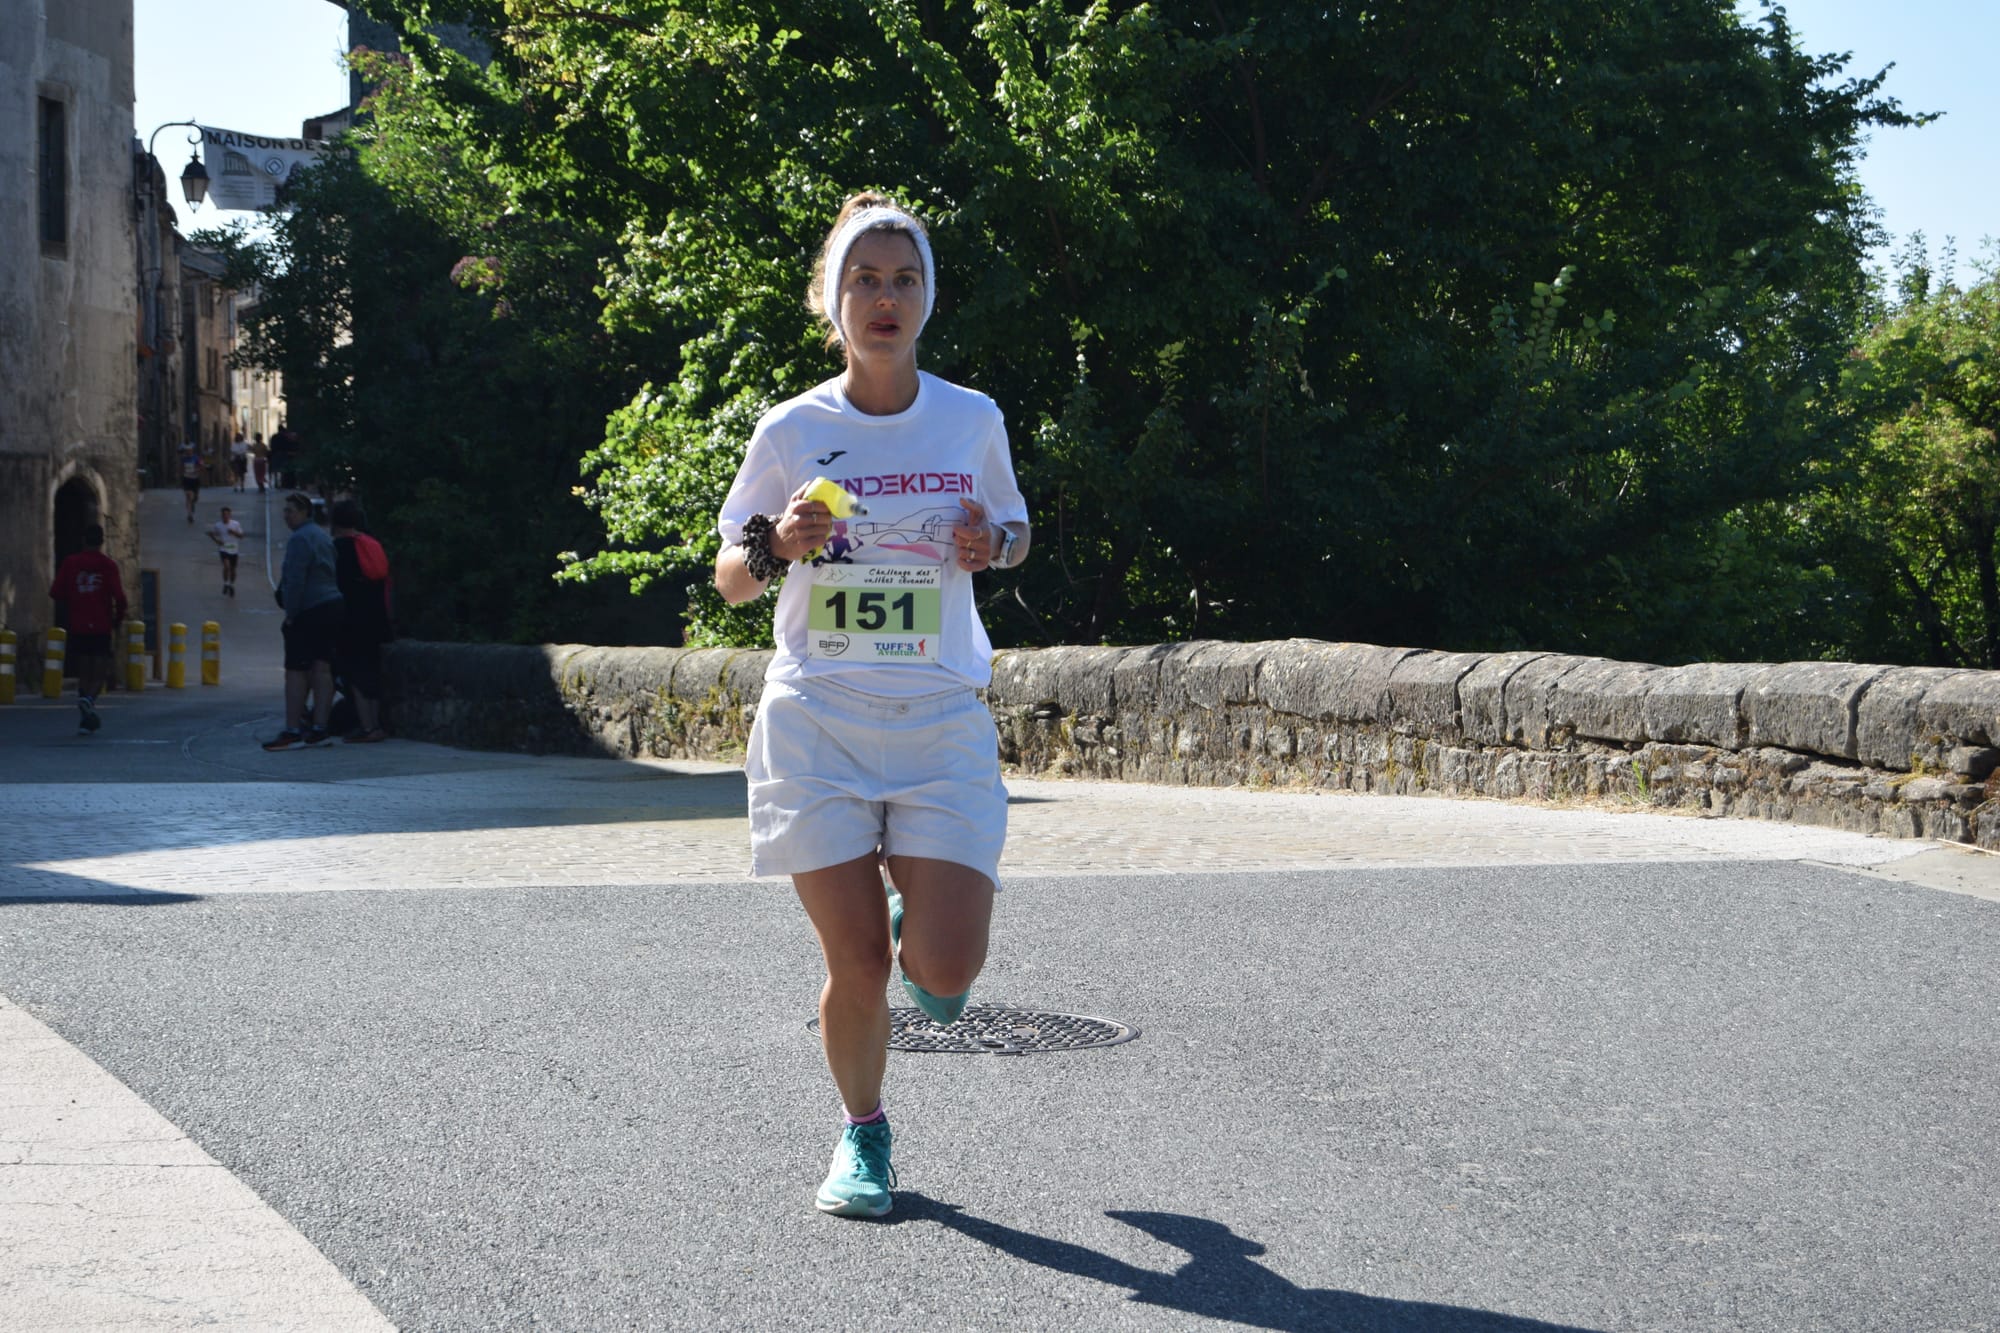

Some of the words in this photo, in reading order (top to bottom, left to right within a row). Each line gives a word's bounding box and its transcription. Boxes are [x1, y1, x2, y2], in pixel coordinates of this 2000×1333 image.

[207, 131, 286, 150] MAISON
[832, 472, 973, 497] NDEKIDEN
[869, 568, 911, 578] Challenge
[916, 568, 930, 577] des
[825, 591, 914, 631] 151
[819, 640, 845, 650] BFP
[874, 642, 914, 651] TUFF'S
